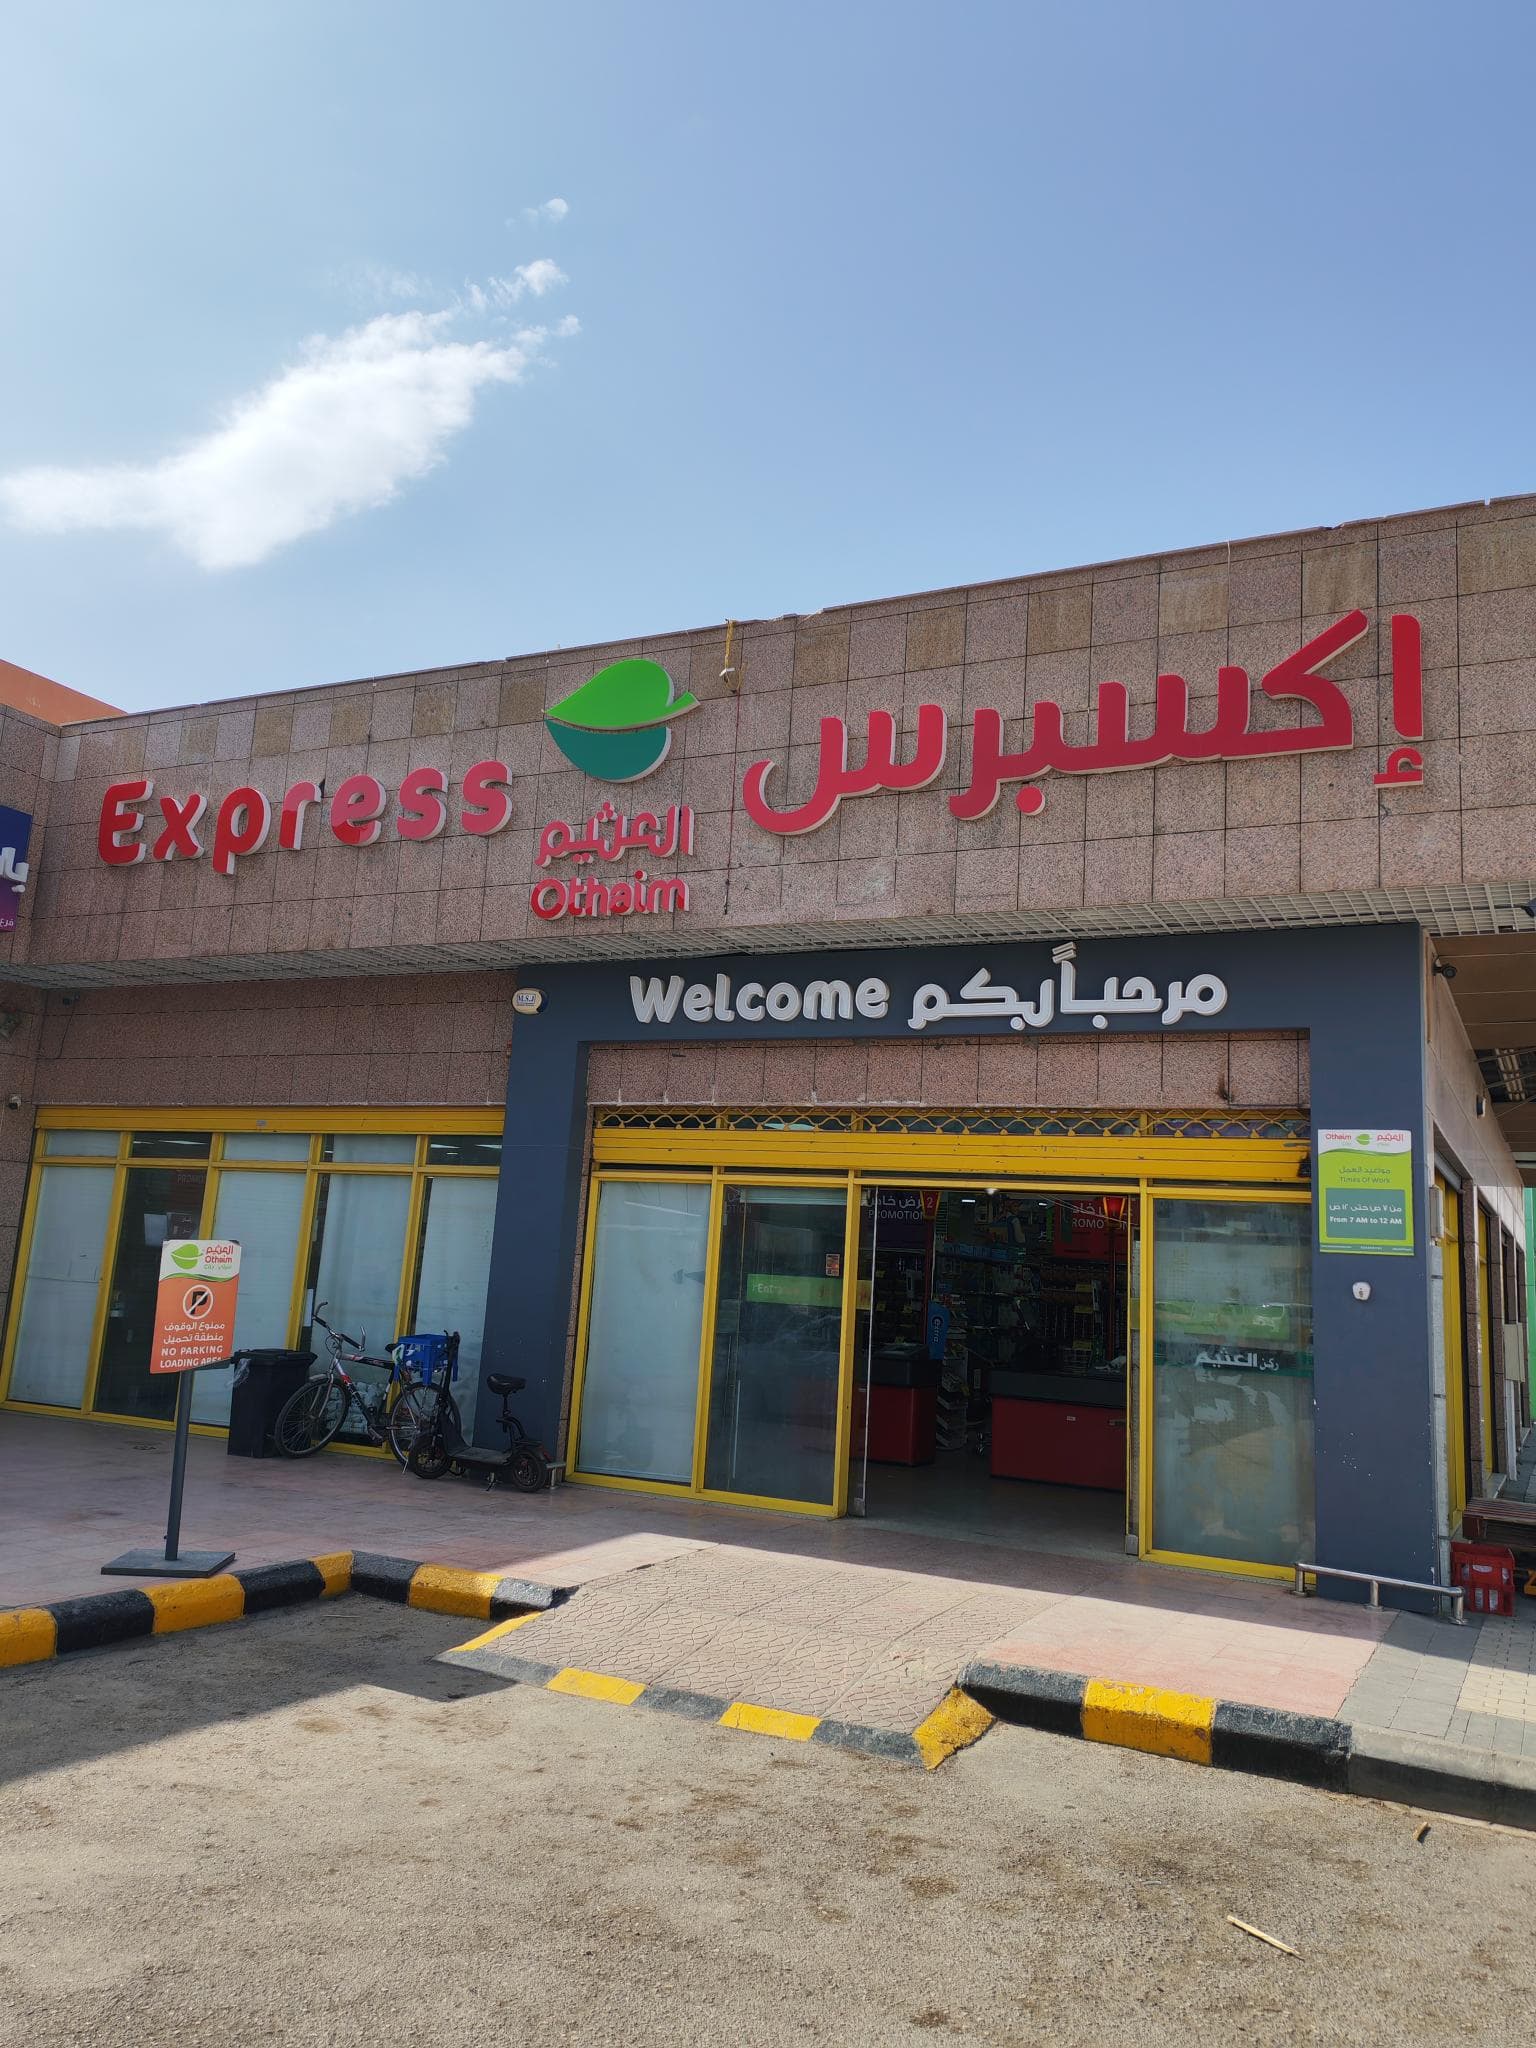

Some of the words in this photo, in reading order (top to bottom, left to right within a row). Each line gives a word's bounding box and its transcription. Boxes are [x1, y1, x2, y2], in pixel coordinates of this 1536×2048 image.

[742, 608, 1424, 834] إكسبرس
[98, 759, 513, 876] Express
[534, 801, 695, 868] العثيم
[530, 870, 690, 921] Othaim
[629, 972, 890, 1025] Welcome
[907, 967, 1054, 1031] بكم
[1325, 1133, 1352, 1141] Othaim
[1376, 1132, 1404, 1142] العثيم
[1339, 1166, 1361, 1175] العمل
[1340, 1176, 1360, 1184] Times
[926, 1196, 934, 1209] 2
[1389, 1204, 1402, 1213] من
[1329, 1216, 1348, 1224] From
[205, 1244, 234, 1256] العثيم
[205, 1255, 232, 1264] Othaim
[164, 1321, 197, 1332] الوقوف
[199, 1321, 225, 1332] ممنوع
[933, 1315, 945, 1344] extra
[163, 1333, 193, 1345] تحميل
[194, 1332, 224, 1342] منطقة
[161, 1347, 177, 1356] NO
[180, 1345, 223, 1355] PARKING
[160, 1358, 200, 1369] LOADING
